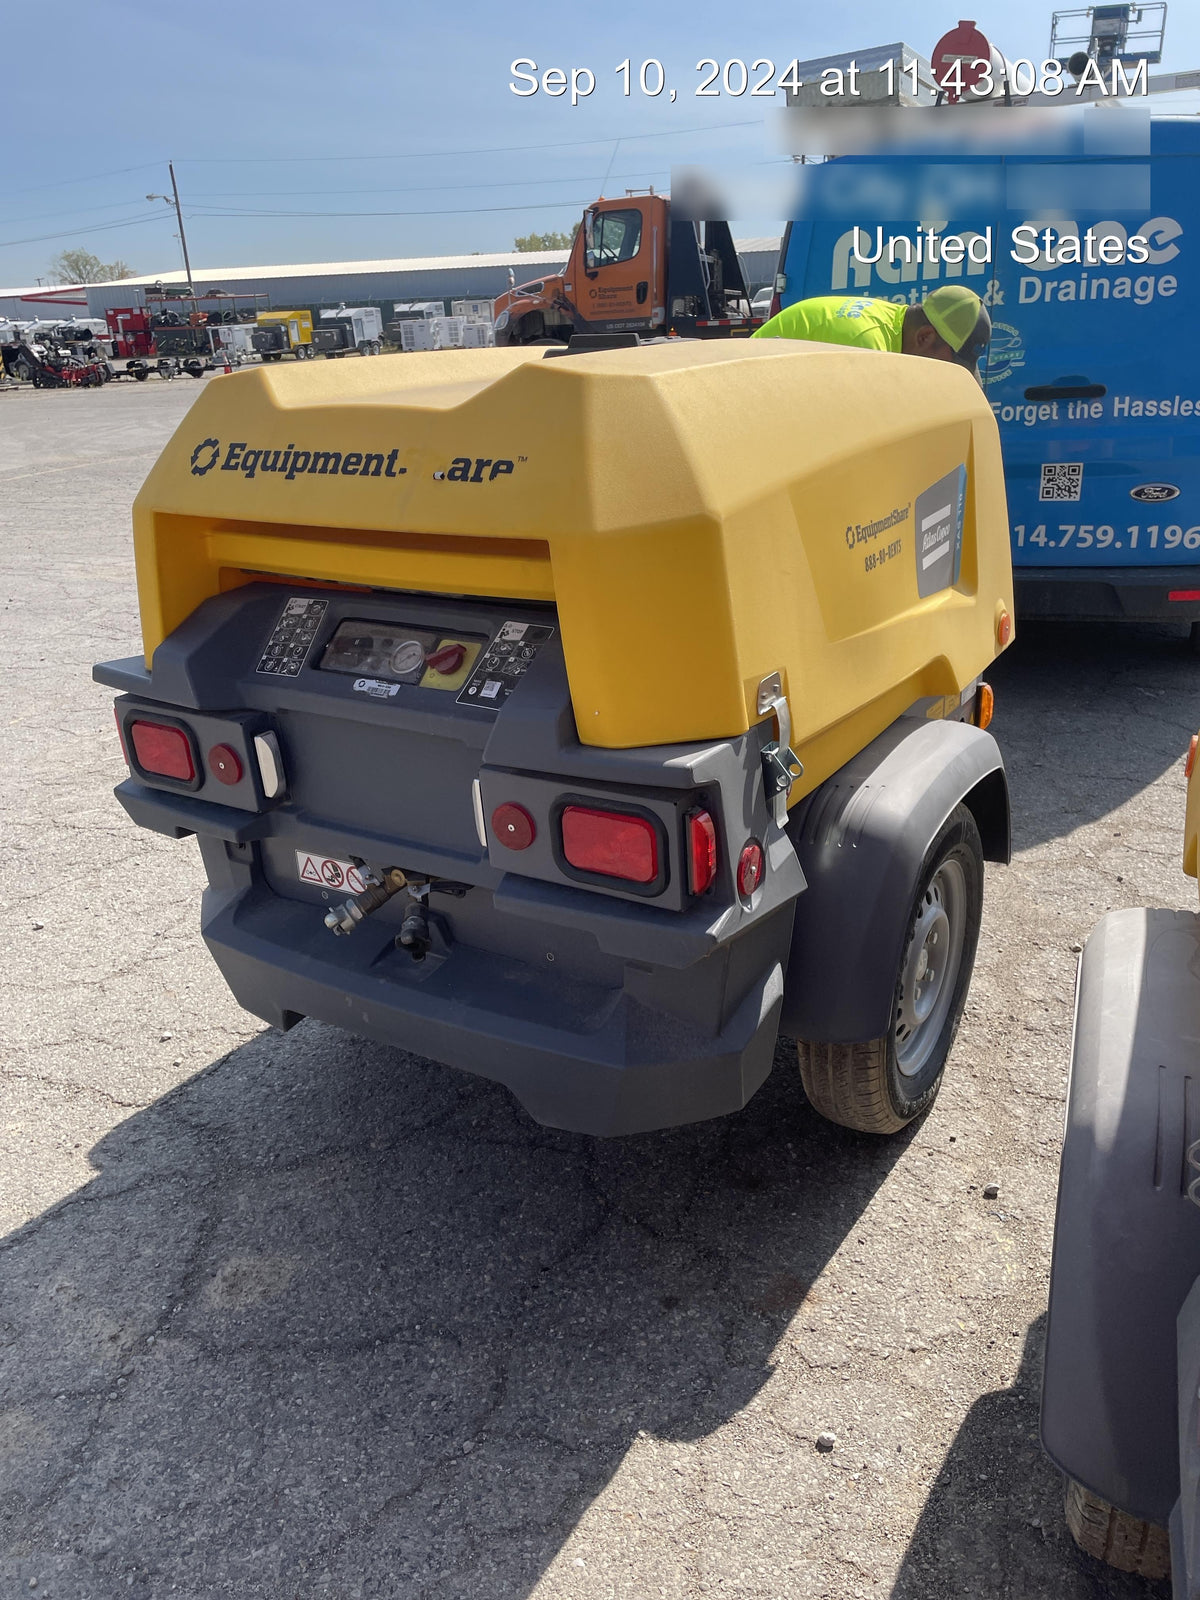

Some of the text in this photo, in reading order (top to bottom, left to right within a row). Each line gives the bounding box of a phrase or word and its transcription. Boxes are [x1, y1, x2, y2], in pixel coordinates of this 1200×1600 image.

[983, 272, 1178, 307] & Drainage
[990, 400, 1059, 427] Forget
[1067, 400, 1104, 420] the
[1140, 487, 1169, 499] Ford
